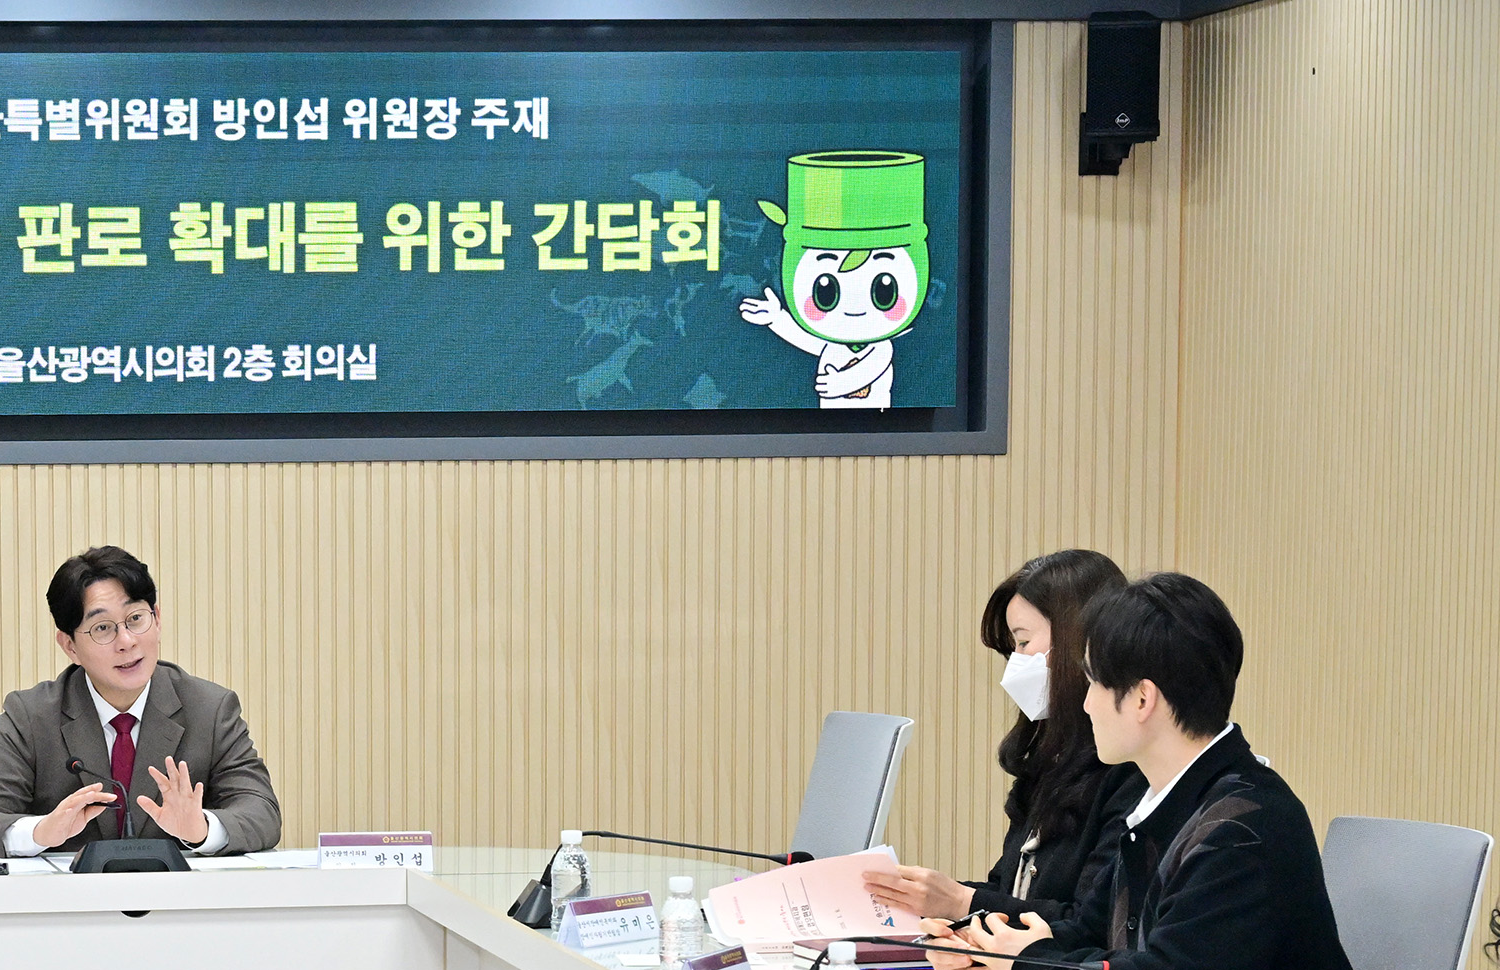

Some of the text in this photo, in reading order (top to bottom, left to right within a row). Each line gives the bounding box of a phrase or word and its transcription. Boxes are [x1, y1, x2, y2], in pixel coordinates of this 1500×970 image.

[212, 97, 329, 141] 방인섭
[342, 96, 462, 141] 위원장
[470, 96, 550, 140] 주재
[16, 202, 149, 273] 판로
[168, 201, 365, 274] 확대를
[382, 201, 513, 273] 위한
[532, 199, 721, 272] 간담회
[223, 345, 276, 382] 2층
[281, 343, 378, 381] 회의실
[324, 850, 367, 858] 울산광역시의회
[375, 852, 422, 867] 방인섭
[620, 914, 655, 933] 유미은
